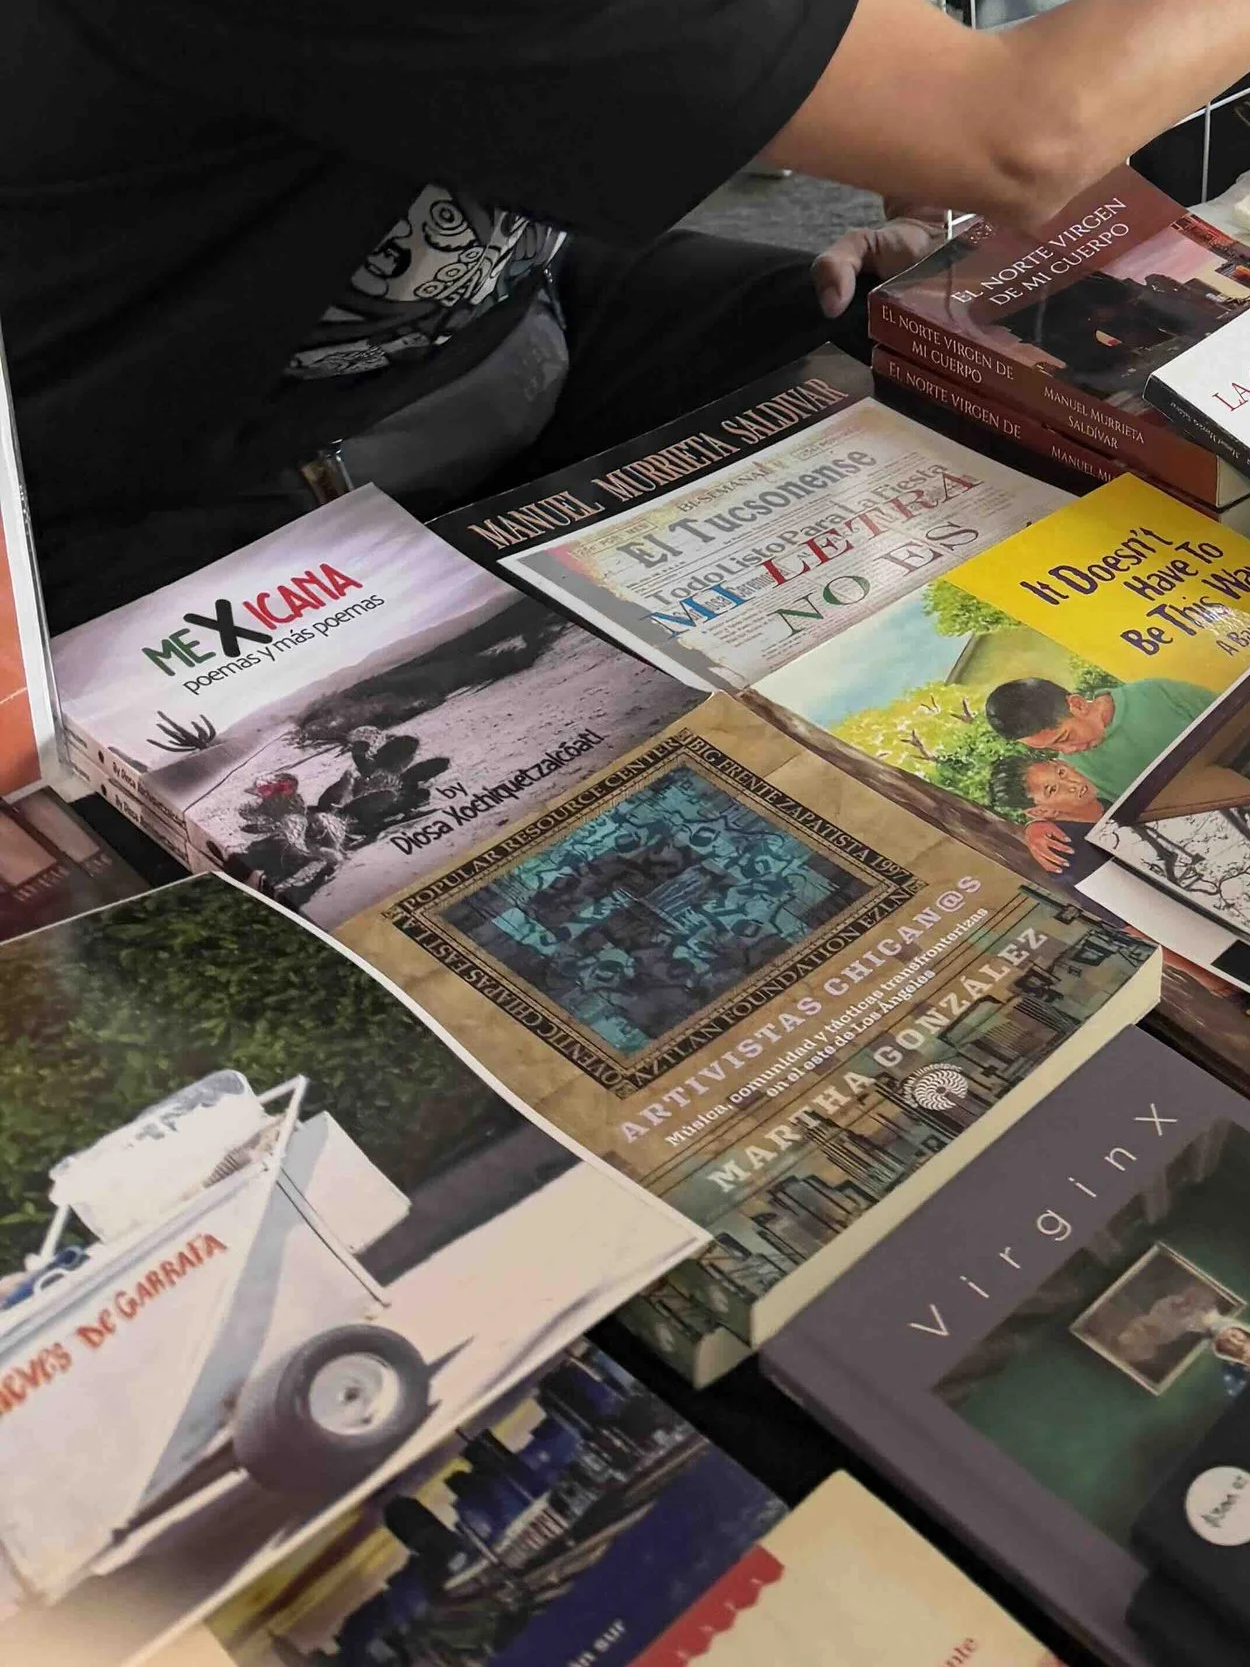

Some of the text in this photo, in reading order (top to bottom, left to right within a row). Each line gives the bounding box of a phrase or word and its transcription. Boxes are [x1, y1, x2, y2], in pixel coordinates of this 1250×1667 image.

[950, 196, 1128, 306] EL NORTE VIRGEN
[987, 221, 1131, 308] DE MI CUERPO
[881, 304, 1016, 381] EL NORTE VIRGEN DE
[910, 340, 984, 385] MI CUERPO
[888, 360, 1022, 441] EL NORTE VIRGEN DE
[1043, 384, 1145, 446] MANUEL MURRIETA
[467, 378, 849, 551] MANUEL MURRIETA SALDIVAR
[616, 448, 878, 570] El Tucsonense
[1050, 445, 1097, 479] MANUEL
[640, 580, 756, 639] MI
[758, 468, 984, 589] LETRA
[646, 564, 725, 610] Todo
[720, 529, 787, 582] Listo
[782, 507, 848, 555] Para
[880, 463, 950, 508] Fiesta
[766, 574, 872, 637] NO
[873, 519, 981, 577] ES
[1019, 526, 1174, 606] It Doesn't
[1124, 540, 1225, 602] Have To
[141, 561, 364, 677] MEXICANA
[182, 591, 386, 696] poemas y más poemas
[1120, 625, 1174, 657] Be
[1146, 595, 1231, 636] This
[1214, 638, 1238, 657] A
[390, 816, 455, 857] Diosa
[402, 735, 680, 912] POPULAR RESOURCE CENTER
[437, 780, 469, 804] by
[689, 736, 911, 884] BIG FRENTE ZAPATISTA 1997
[424, 935, 622, 1088] OVENTIC CHIAPAS EAST
[617, 874, 984, 1146] ARTIVISTAS CHICAN@S
[633, 887, 918, 1088] AZTLAN FOUNDATION EZLN
[728, 1038, 820, 1107] comunidad
[812, 1031, 829, 1051] y
[825, 986, 888, 1035] tácticas
[877, 906, 990, 1001] transfronterizas
[706, 925, 1050, 1196] MARTHA GONZÁLEZ
[765, 1079, 788, 1100] en
[784, 1066, 804, 1085] el
[801, 1044, 837, 1075] este
[830, 1028, 857, 1052] de
[850, 1008, 882, 1039] Los
[114, 1232, 230, 1322] GARRAFA
